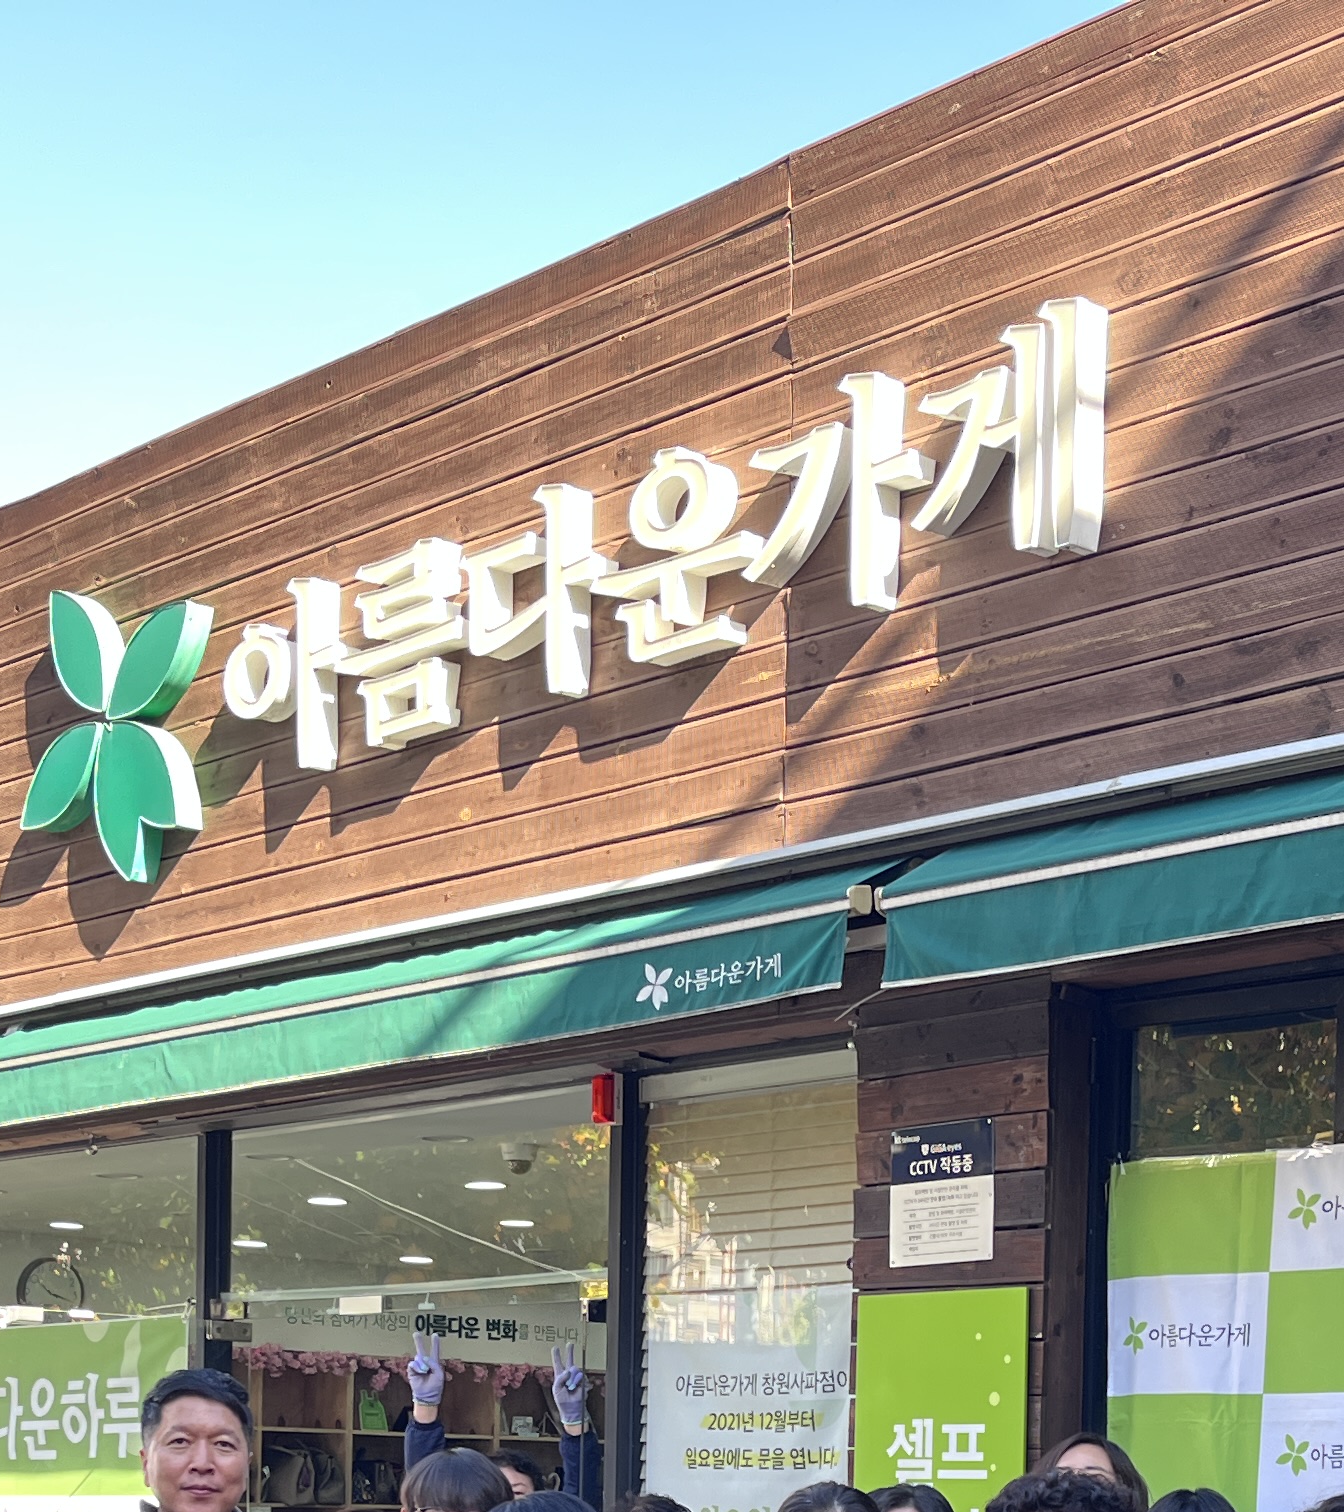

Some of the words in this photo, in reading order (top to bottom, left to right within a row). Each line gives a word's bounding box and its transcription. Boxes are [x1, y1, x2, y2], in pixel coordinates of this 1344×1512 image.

[222, 296, 1109, 771] 아름다운가게
[674, 952, 782, 994] 아름다운가게
[909, 1160, 938, 1176] CCTV
[940, 1154, 974, 1174] 작동중
[372, 1313, 411, 1332] 세상의
[415, 1314, 480, 1339] 아름다운
[1148, 1322, 1252, 1350] 아름다운가게
[676, 1373, 757, 1397] 아름다운가게
[707, 1412, 755, 1432] 2021년
[759, 1409, 816, 1432] 12월부터
[686, 1447, 754, 1470] 일요일에도
[757, 1447, 786, 1470] 문을
[790, 1446, 838, 1470] 엽니다.
[886, 1418, 988, 1488] 셀프
